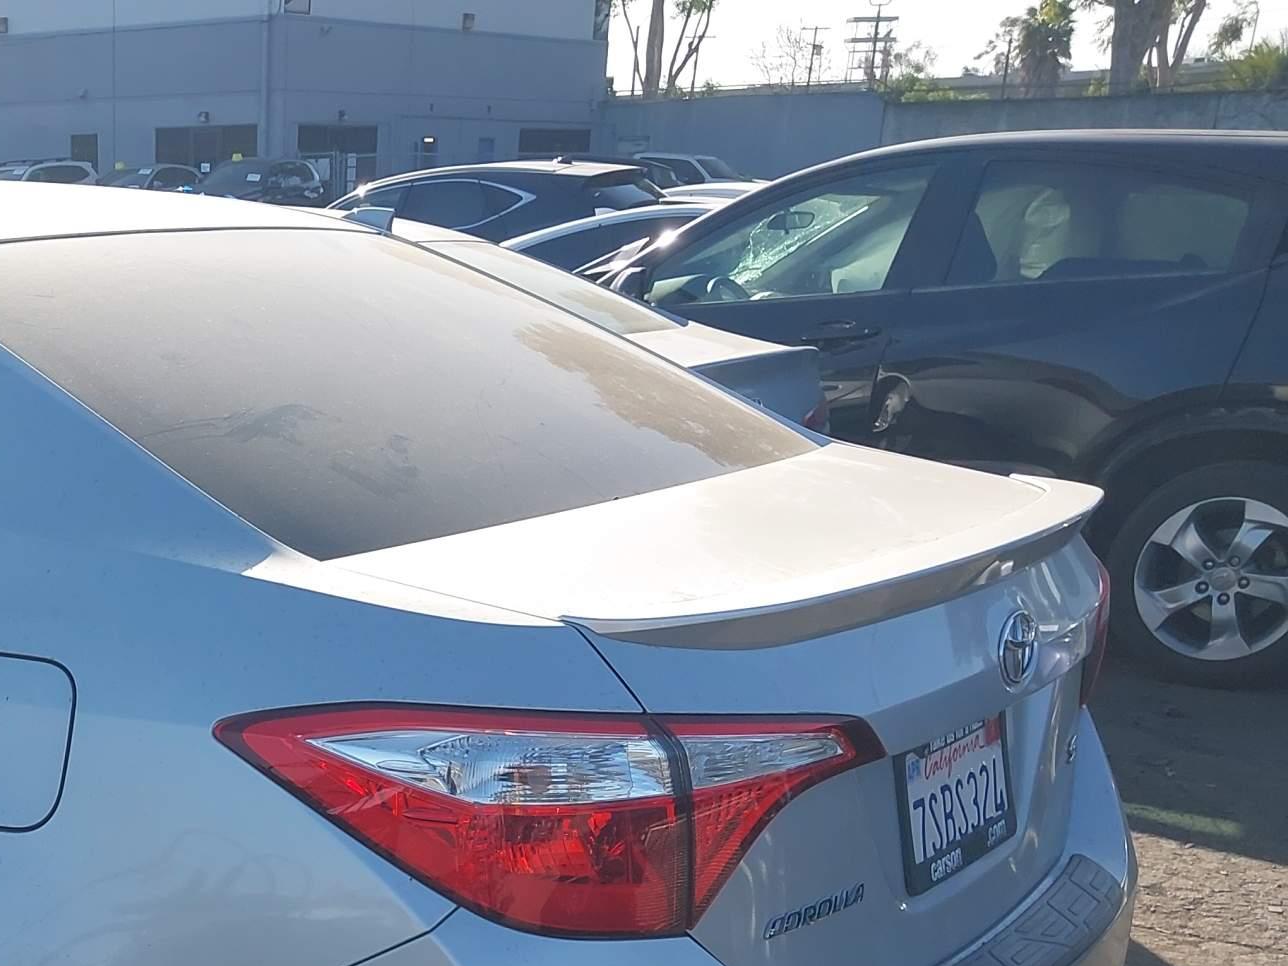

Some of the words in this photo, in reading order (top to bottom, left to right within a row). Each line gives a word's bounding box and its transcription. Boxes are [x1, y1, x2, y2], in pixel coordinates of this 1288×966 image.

[924, 734, 985, 780] California
[931, 848, 963, 881] carson
[763, 882, 864, 940] COROLLA
